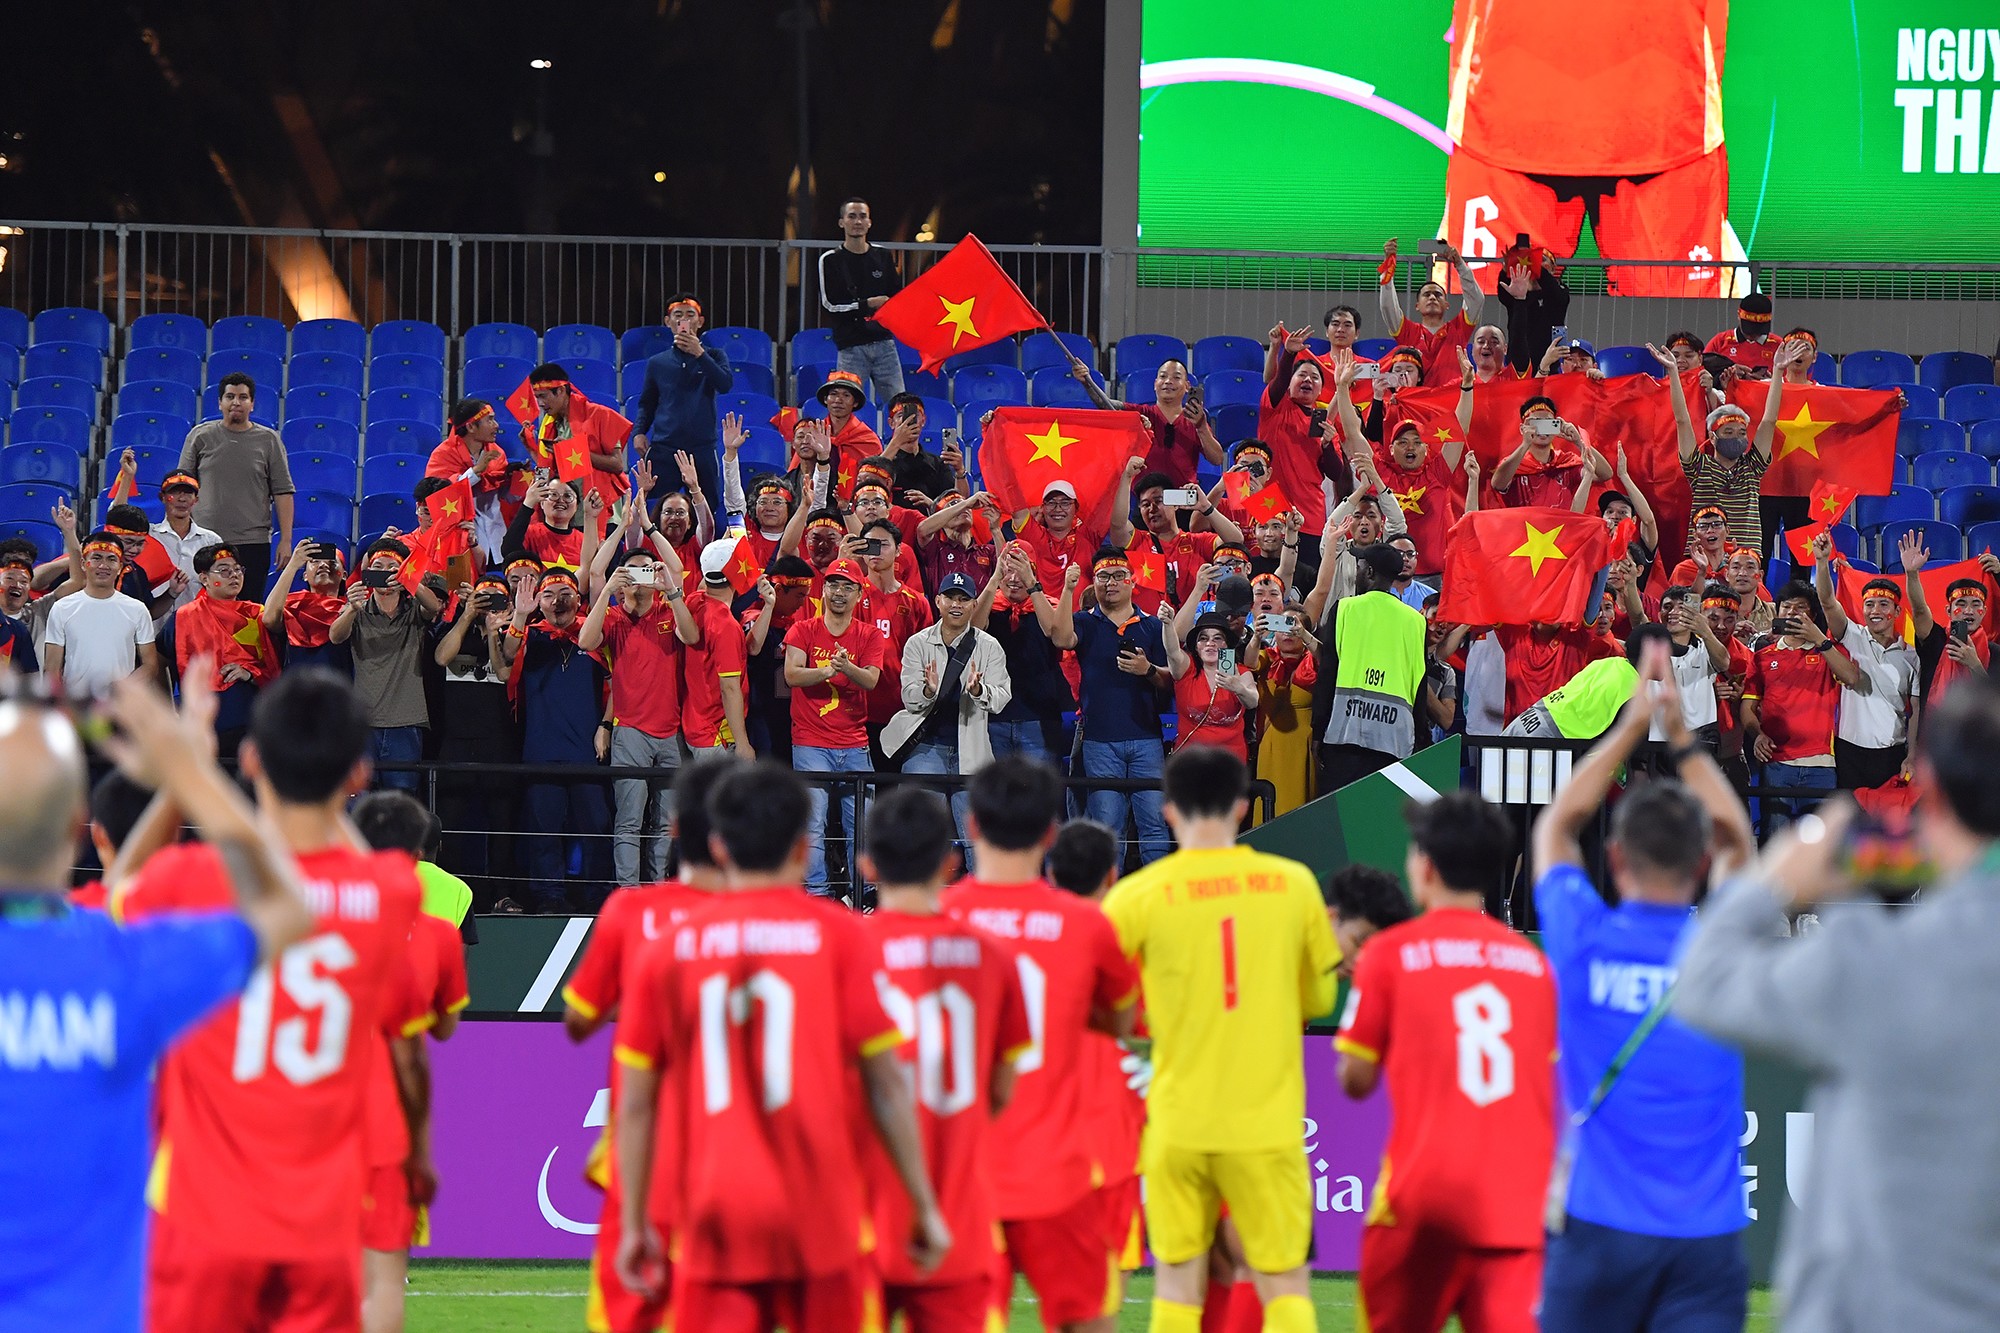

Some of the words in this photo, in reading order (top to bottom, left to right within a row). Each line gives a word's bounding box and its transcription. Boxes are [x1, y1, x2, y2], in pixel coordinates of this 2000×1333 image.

[1462, 195, 1499, 270] 6
[953, 573, 964, 585] LA
[1058, 553, 1068, 570] 7
[1345, 698, 1398, 725] STEWARD
[1364, 667, 1385, 687] 1891
[1221, 917, 1238, 1012] 1
[232, 932, 358, 1087] 15
[698, 968, 796, 1118] 17
[1453, 981, 1515, 1108] 8
